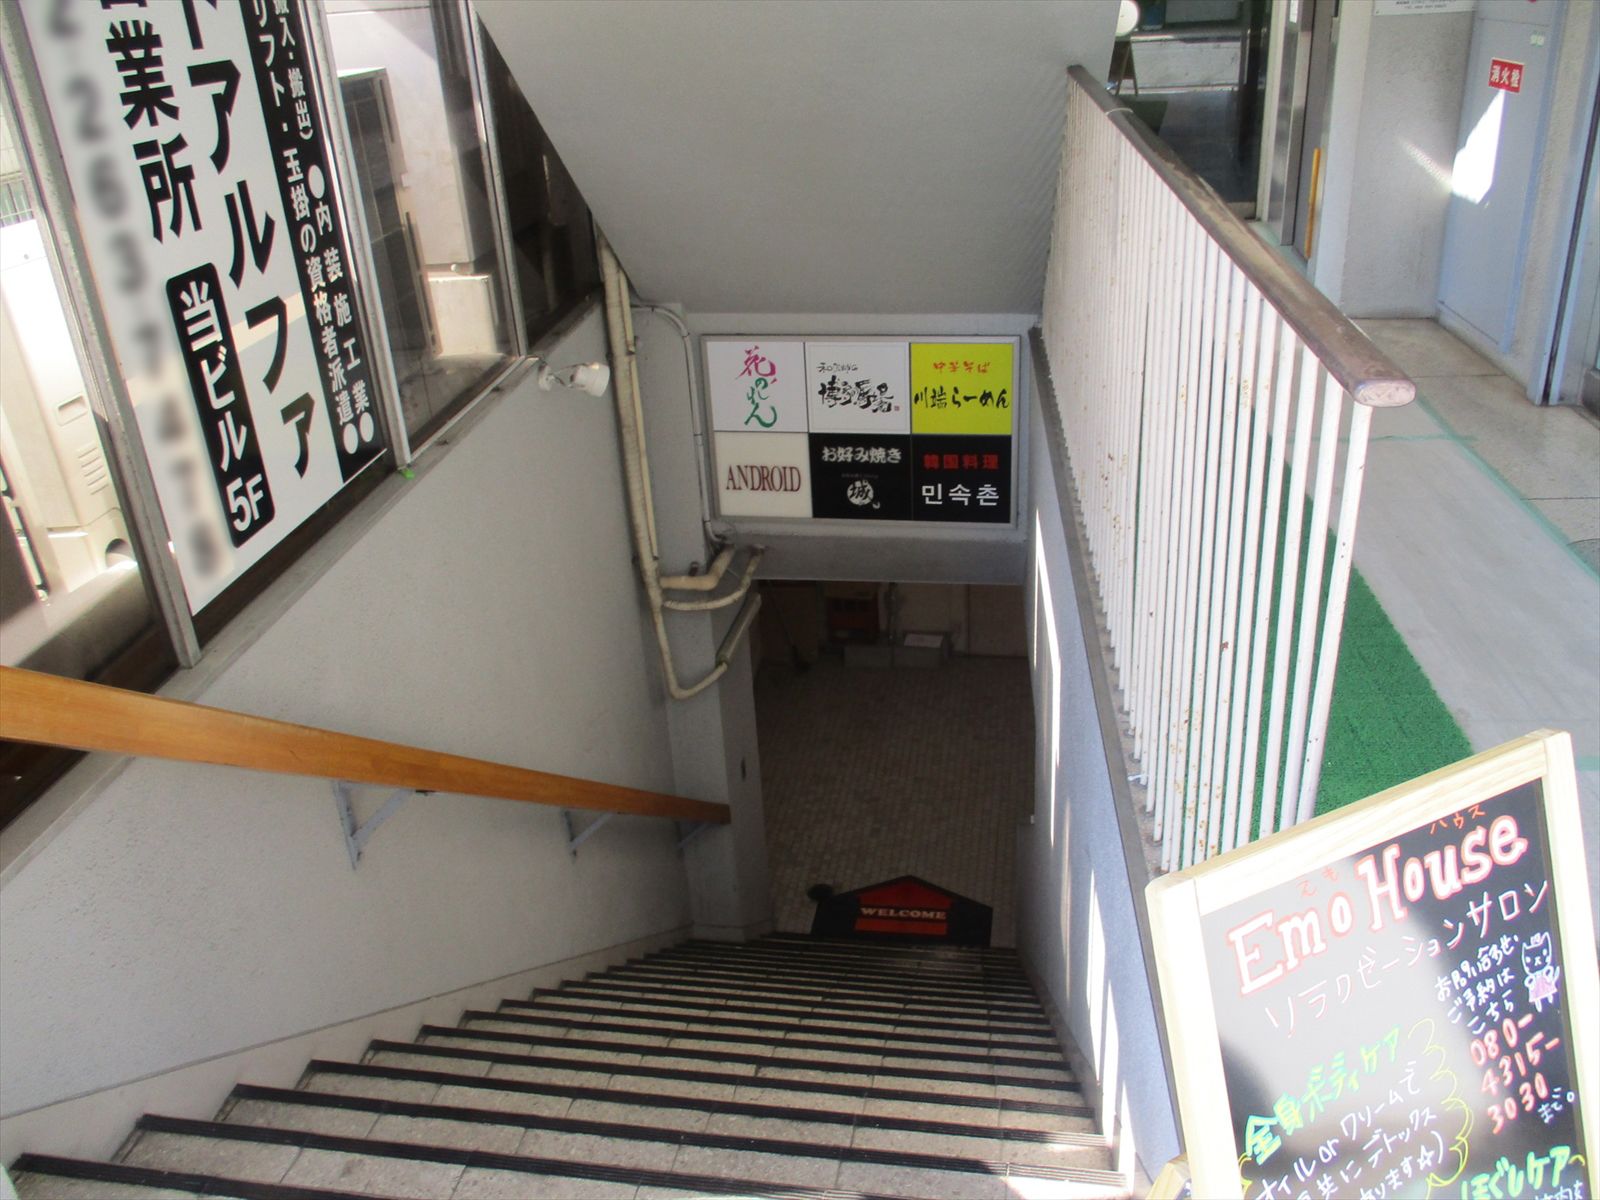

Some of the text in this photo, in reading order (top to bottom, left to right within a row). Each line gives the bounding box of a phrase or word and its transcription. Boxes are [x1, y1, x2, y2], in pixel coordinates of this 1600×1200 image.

[1490, 65, 1521, 87] 消火栓
[101, 0, 203, 242] 業所
[914, 385, 1010, 409] 川端らーめん
[821, 446, 902, 464] お好み焼き
[725, 464, 802, 493] ANDROID
[921, 483, 1000, 507] 민속촌
[1430, 803, 1486, 835] ハウス
[860, 907, 947, 920] WELCOME
[1226, 814, 1530, 1000] Emo House
[1447, 966, 1516, 1024] ご予約は
[1466, 988, 1515, 1036] こちら
[1245, 1023, 1401, 1166] 全身ボディケア
